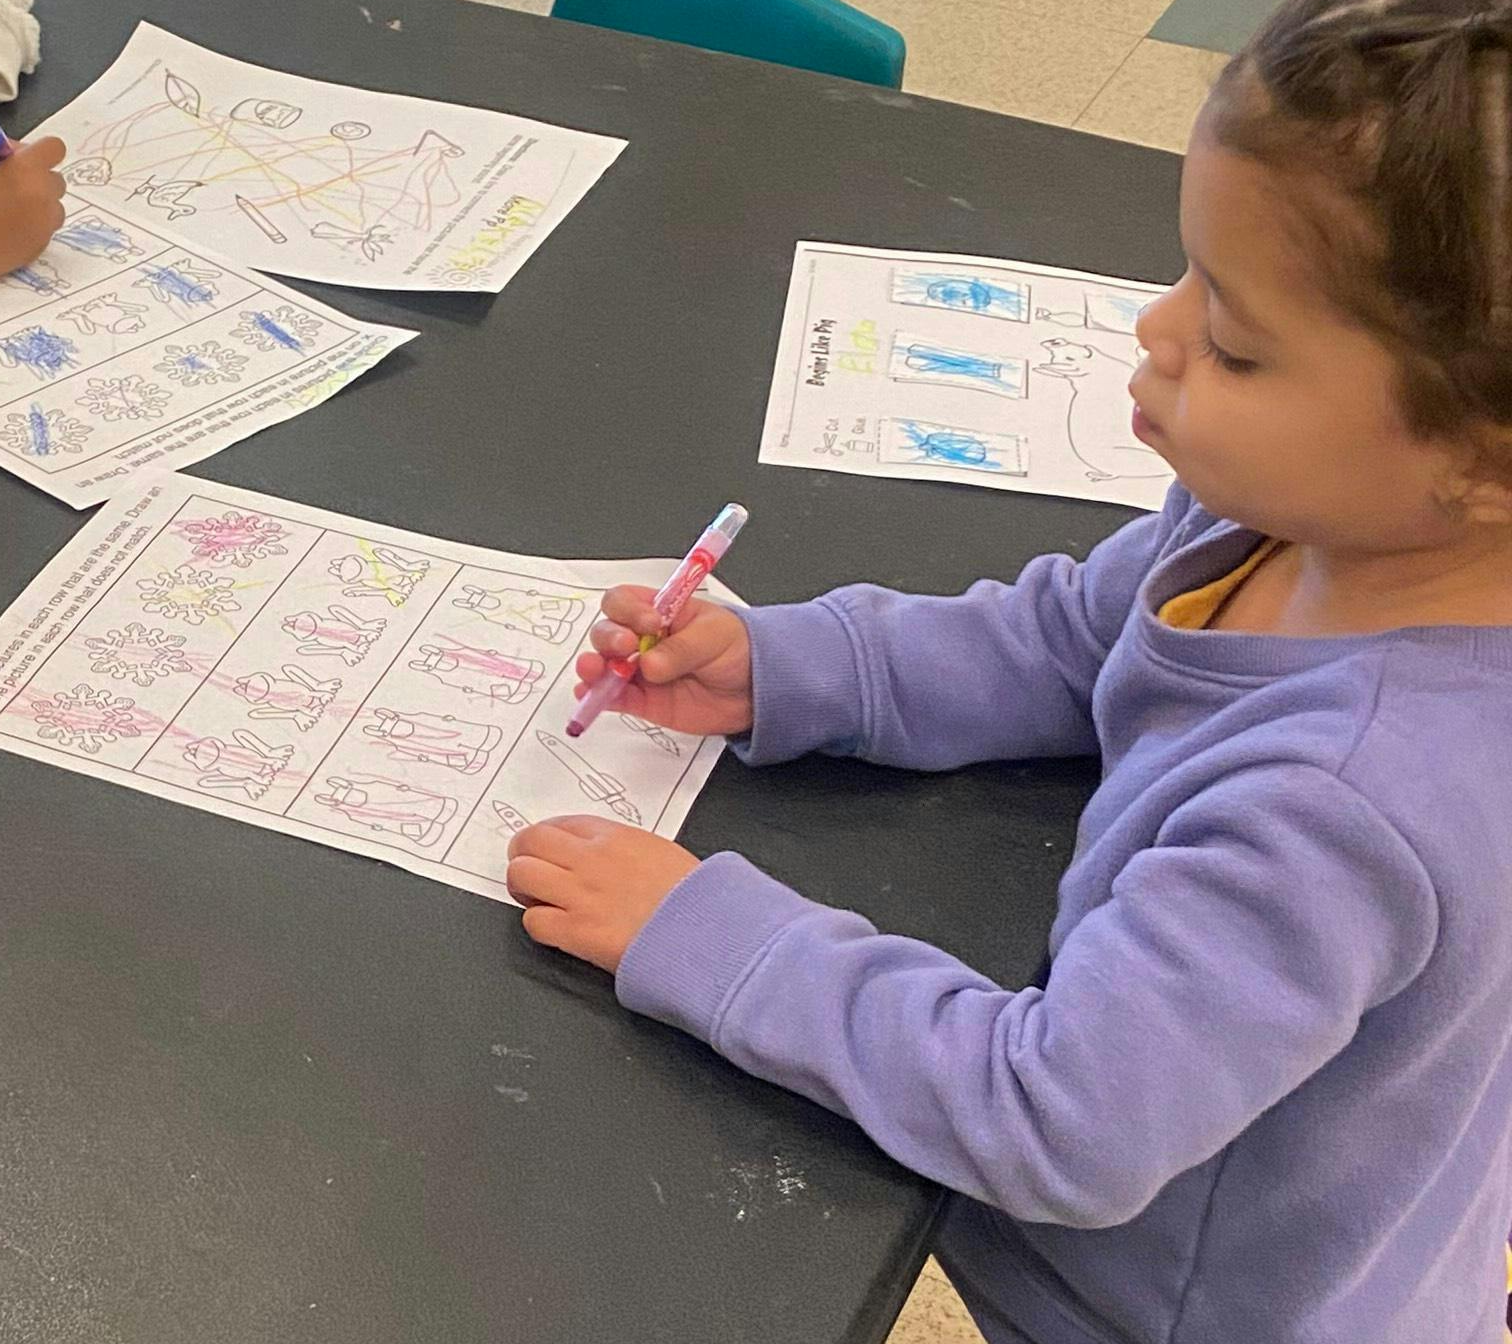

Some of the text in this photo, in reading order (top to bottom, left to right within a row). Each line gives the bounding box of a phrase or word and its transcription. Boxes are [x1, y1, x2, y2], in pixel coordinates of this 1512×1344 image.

[806, 353, 829, 387] Begins
[811, 335, 833, 354] Like
[28, 609, 52, 634] each
[48, 587, 69, 610] row
[62, 570, 84, 594] that
[79, 555, 98, 576] are
[92, 540, 110, 559] the
[125, 493, 154, 519] Draw
[5, 654, 37, 689] picture
[41, 622, 65, 645] each
[60, 605, 81, 624] row
[76, 585, 97, 607] that
[91, 563, 115, 588] does
